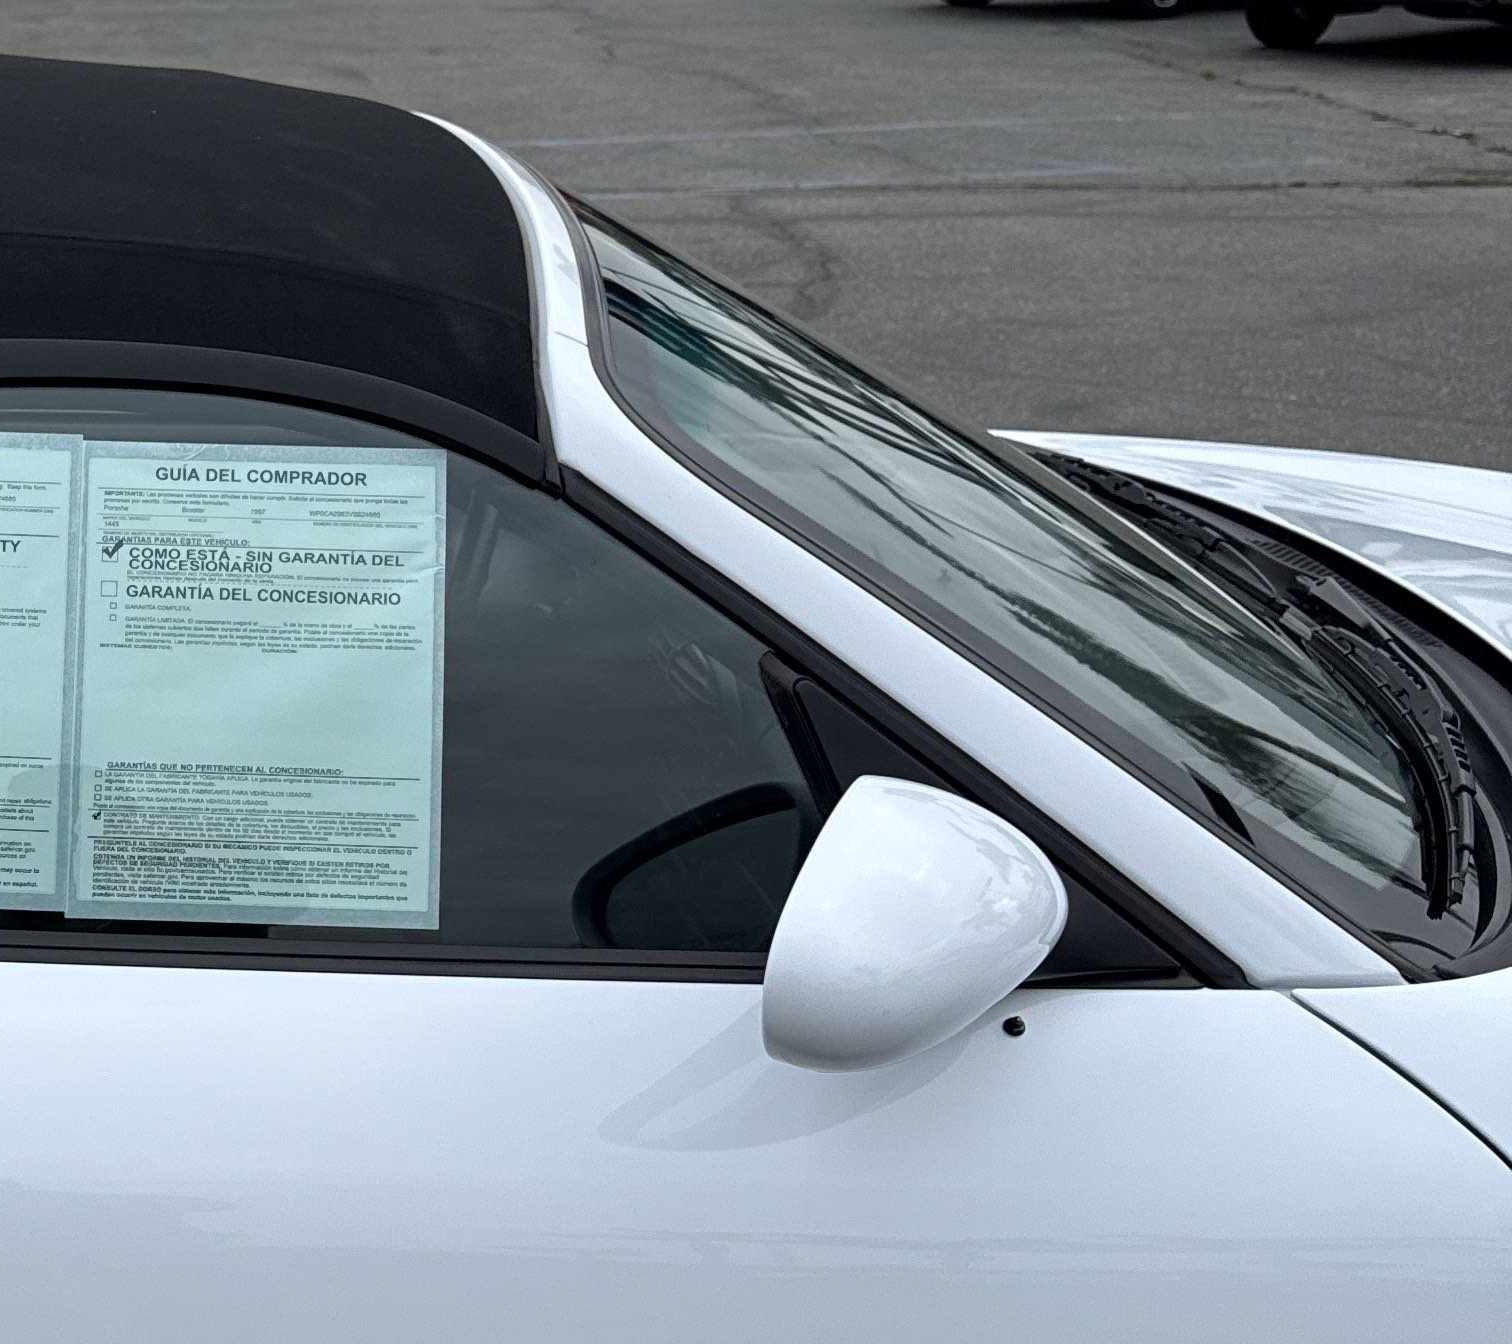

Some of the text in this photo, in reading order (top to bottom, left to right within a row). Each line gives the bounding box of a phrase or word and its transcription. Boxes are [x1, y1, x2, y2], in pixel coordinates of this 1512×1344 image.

[155, 464, 368, 487] GUÍA DEL COMPRADOR
[154, 536, 178, 546] PARA
[180, 537, 202, 546] ESTE
[129, 547, 181, 560] COMO
[186, 546, 231, 561] ESTÁ
[246, 551, 273, 563] SIN
[278, 550, 368, 566] GARANTÍA
[371, 554, 405, 567] DEL
[128, 559, 273, 574] CONCESIONARIO
[125, 583, 402, 606] GARANTÍA DEL CONCESIONARIO
[160, 762, 177, 771] QUE
[181, 762, 193, 772] NO
[195, 763, 253, 774] PERTENECEN
[256, 765, 266, 774] AL
[269, 765, 344, 776] CONCESIONARIO:
